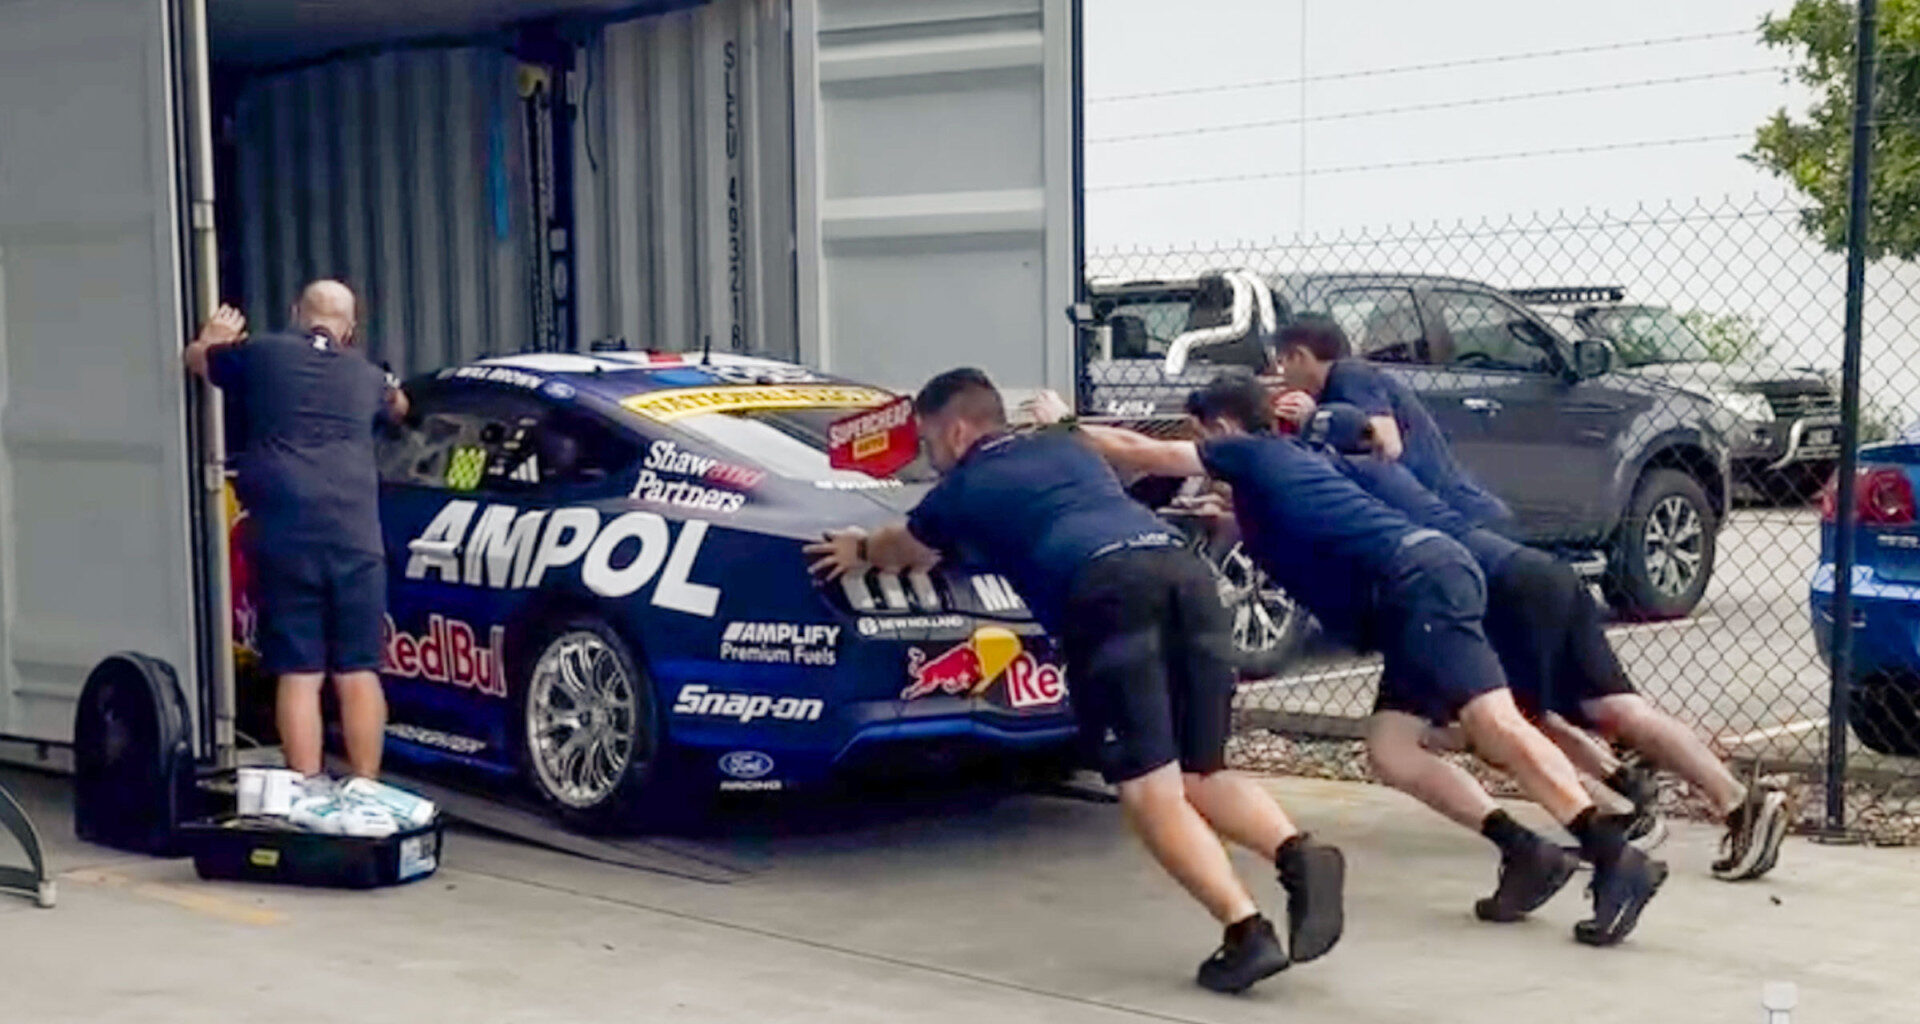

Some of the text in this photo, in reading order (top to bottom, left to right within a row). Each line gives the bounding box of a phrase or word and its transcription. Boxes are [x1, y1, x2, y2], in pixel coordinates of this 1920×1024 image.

[829, 398, 912, 449] SUPERCHEAP
[643, 440, 766, 488] Shaw and
[630, 469, 746, 514] Partners
[405, 499, 721, 617] AMPOL
[738, 622, 842, 647] AMPLIFY
[879, 615, 964, 630] NEW HOLLAND
[720, 641, 837, 666] Premium Fuels
[1005, 650, 1067, 707] Re
[672, 684, 825, 723] Snap-on
